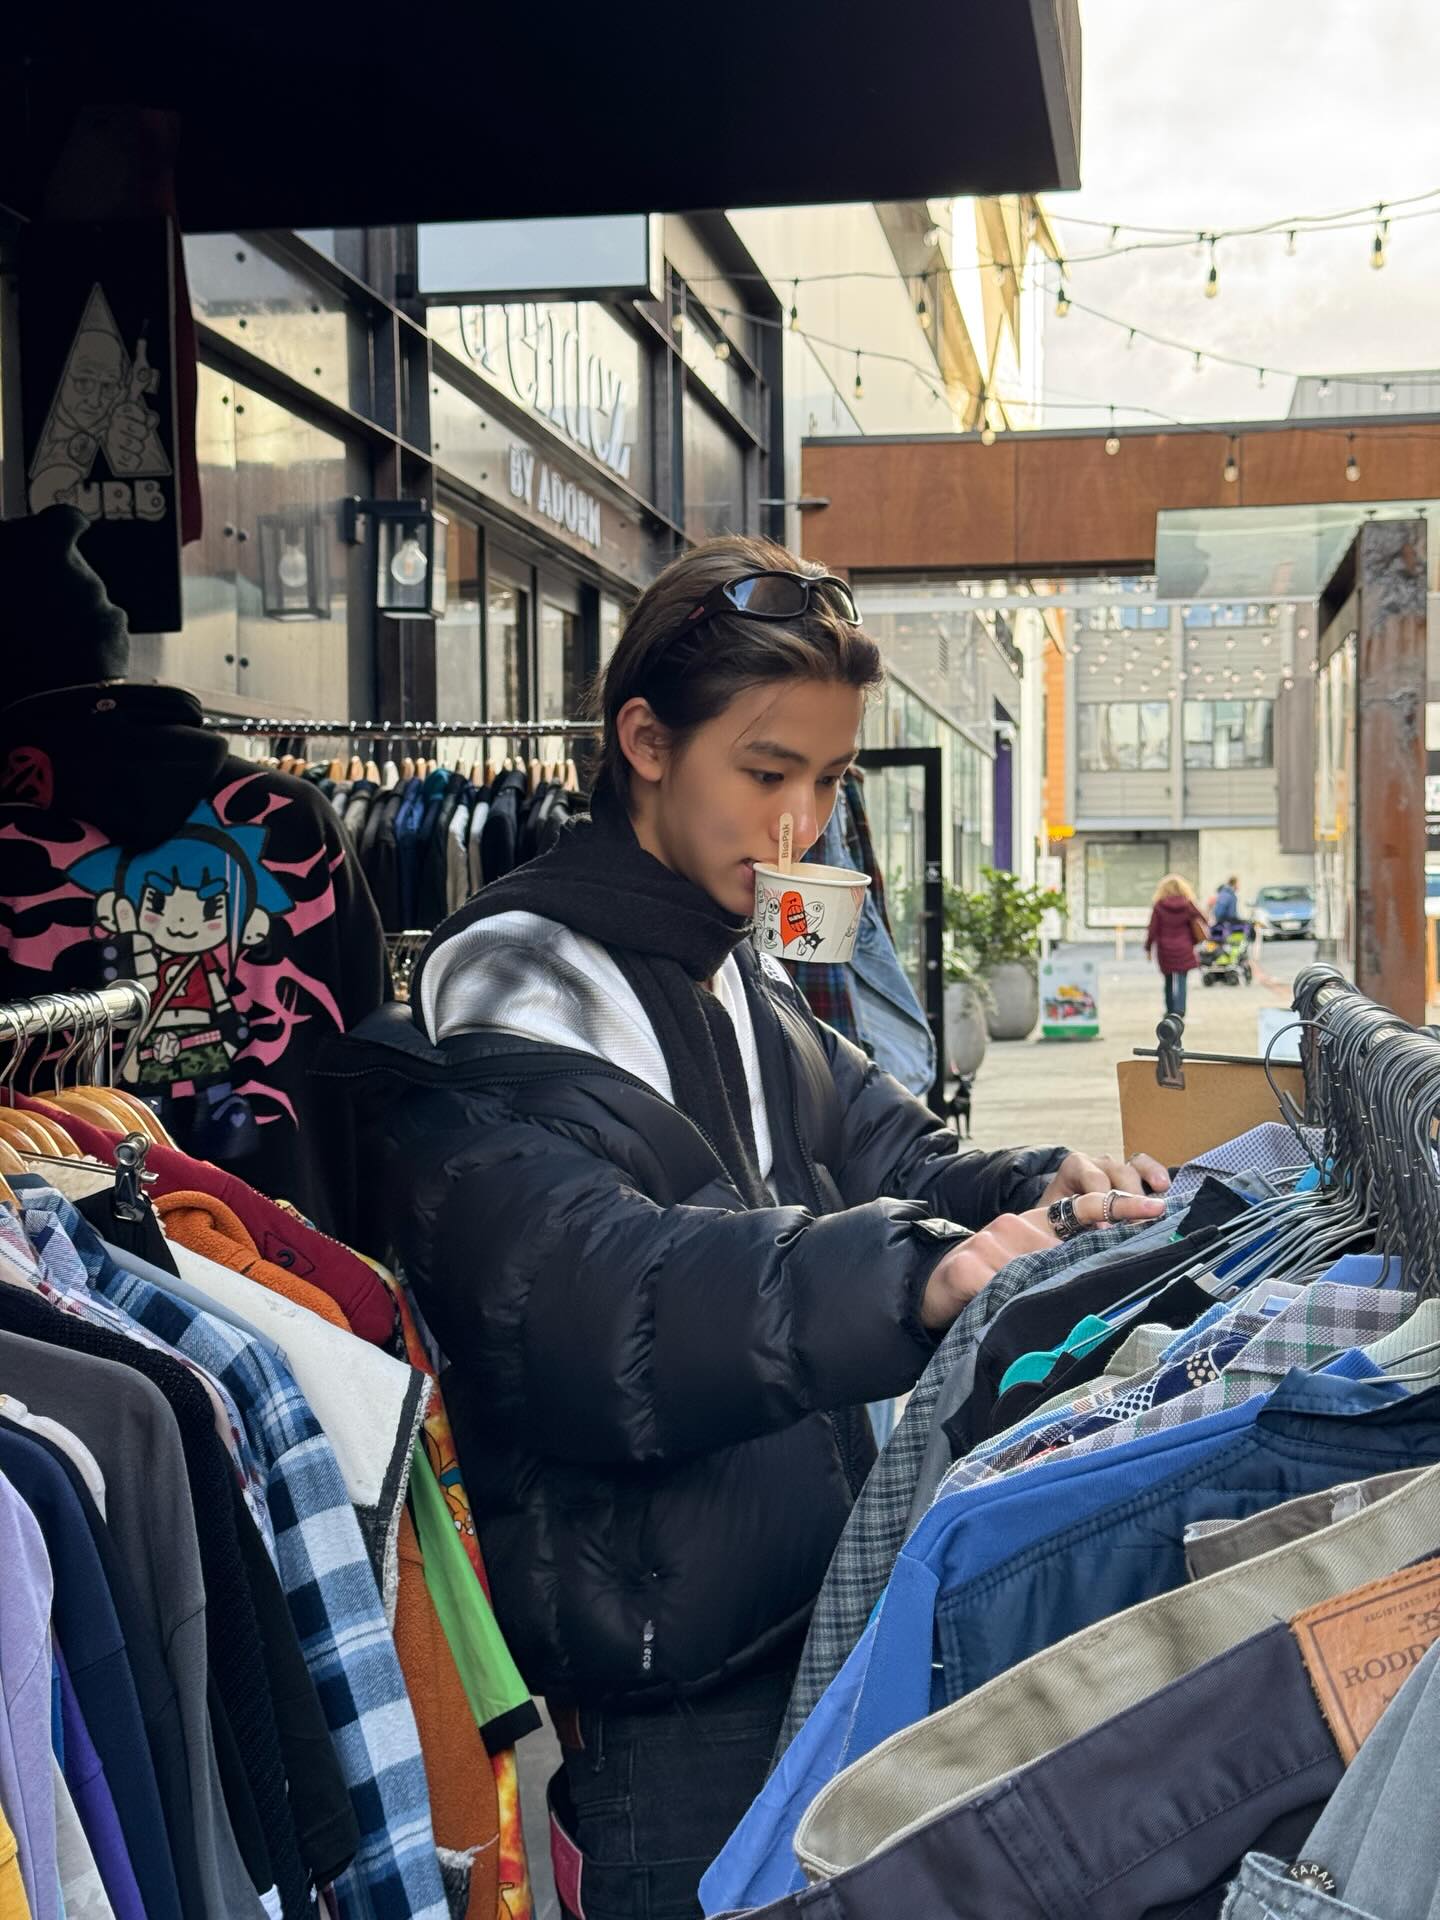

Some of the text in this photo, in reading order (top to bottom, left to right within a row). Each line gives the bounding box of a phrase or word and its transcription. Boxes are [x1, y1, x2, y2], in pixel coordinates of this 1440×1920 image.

[509, 444, 602, 549] BY ADORN
[1290, 1864, 1335, 1890] FARAH
